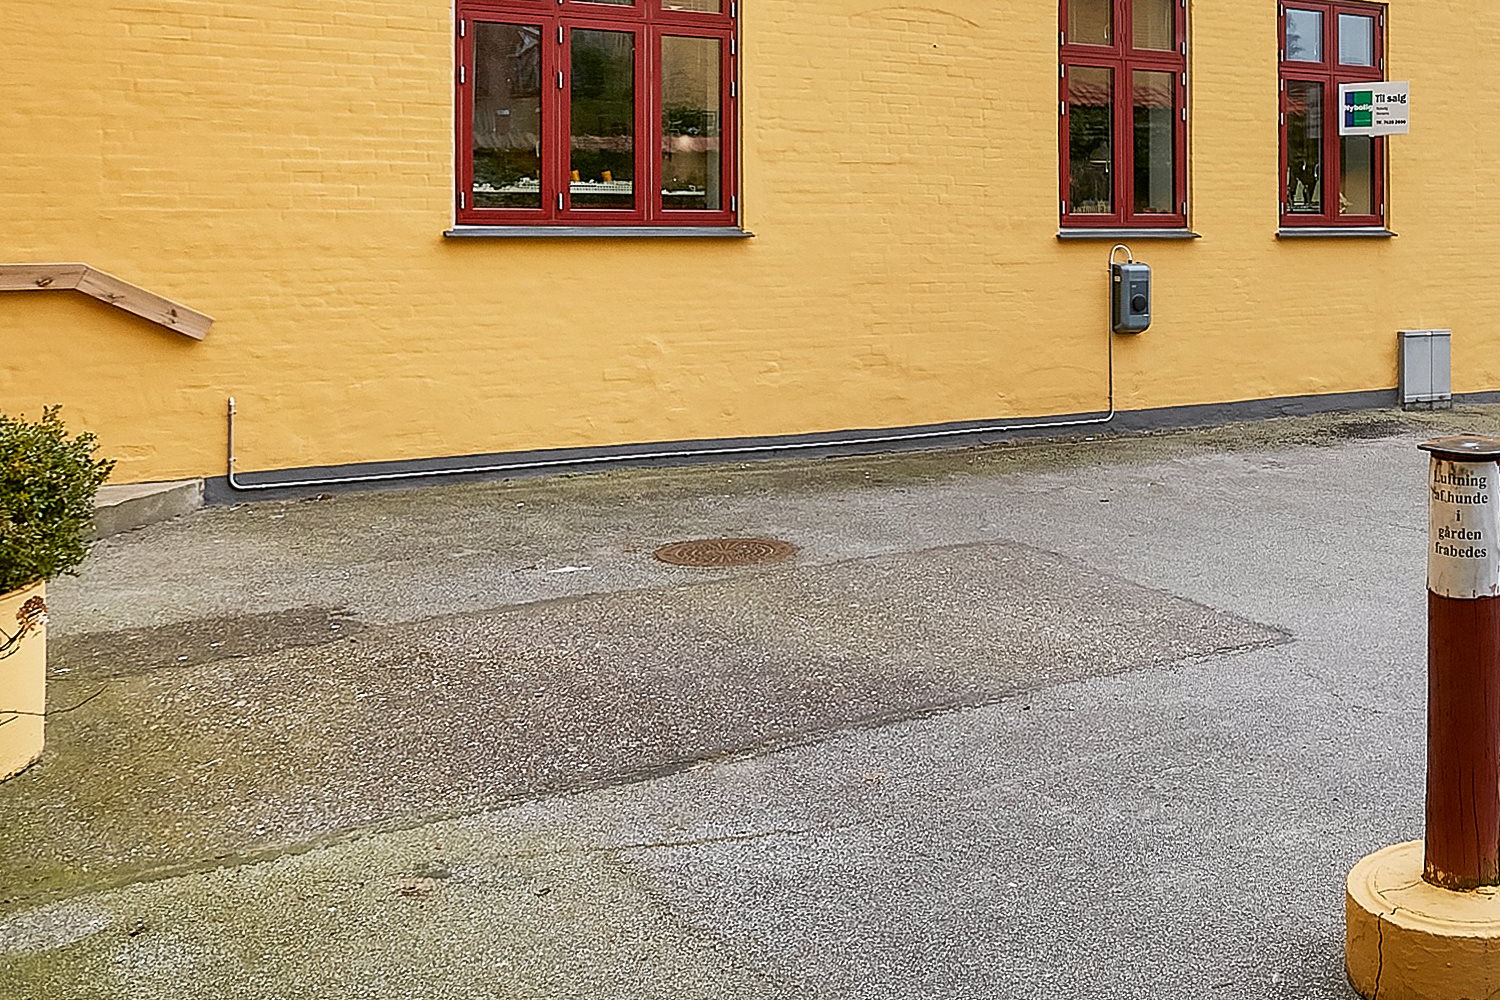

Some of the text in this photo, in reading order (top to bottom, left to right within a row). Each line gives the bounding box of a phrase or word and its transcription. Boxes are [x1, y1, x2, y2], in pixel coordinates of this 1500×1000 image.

[1375, 94, 1406, 104] Til salg
[1344, 104, 1373, 112] Nybolig
[1434, 470, 1487, 489] Luftning
[1434, 490, 1488, 504] af hunde
[1456, 510, 1461, 521] i
[1438, 526, 1481, 540] gården
[1435, 542, 1487, 558] frabedes
